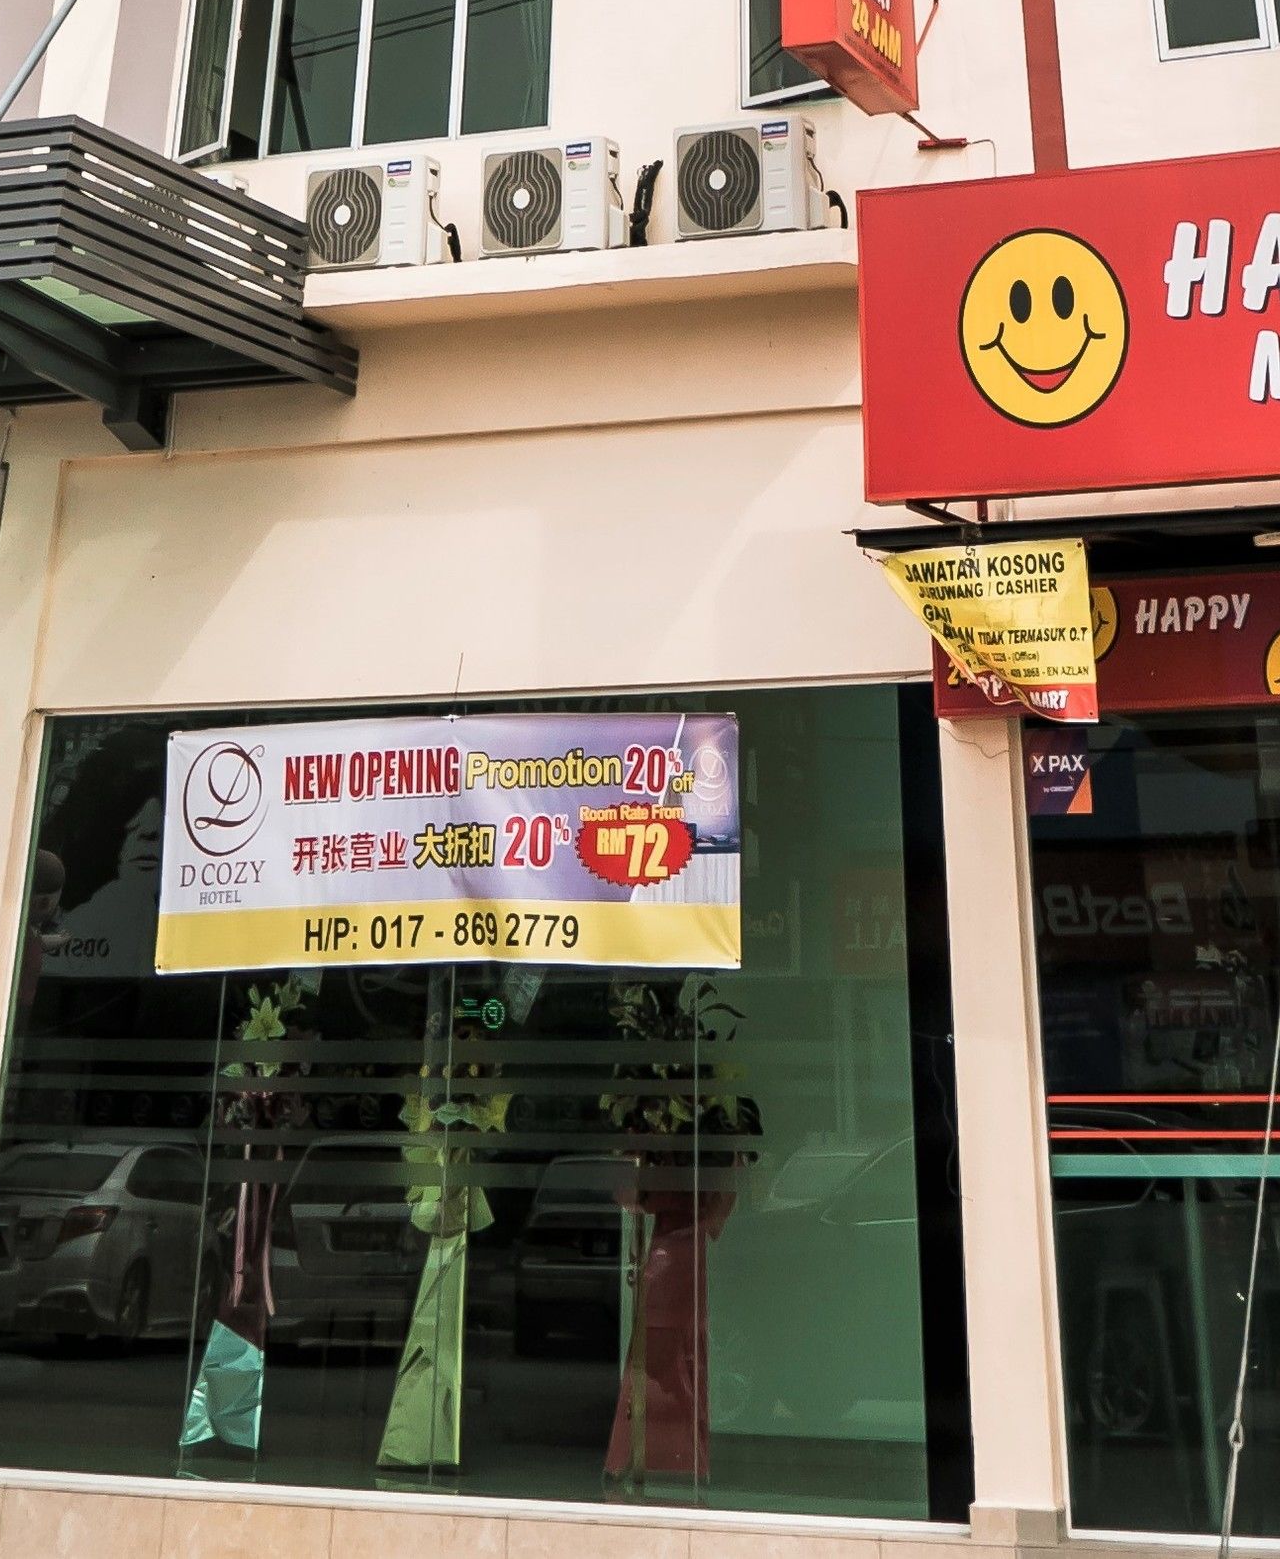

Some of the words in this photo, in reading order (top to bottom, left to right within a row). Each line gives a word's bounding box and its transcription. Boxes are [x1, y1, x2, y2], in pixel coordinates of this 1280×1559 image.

[871, 11, 903, 69] JAM
[904, 558, 981, 584] JAWATAN
[987, 551, 1066, 577] KOSONG
[996, 578, 1058, 596] CASHIER
[1134, 593, 1252, 635] HAPPY
[1008, 627, 1066, 644] TERMASUK
[1030, 689, 1069, 710] MART
[283, 754, 346, 803] NEW
[348, 746, 461, 799] OPENING
[464, 747, 623, 790] Promotion
[671, 771, 695, 793] off
[578, 805, 618, 822] Room
[620, 804, 649, 821] Rate
[651, 803, 685, 820] From
[292, 836, 407, 875] 开张营业
[413, 825, 495, 870] 大折扣
[180, 866, 197, 888] D
[201, 859, 267, 888] COZY
[199, 890, 242, 906] HOTEL
[304, 918, 359, 953] H/P:
[370, 914, 426, 950] 017
[453, 913, 498, 948] 869
[505, 914, 580, 949] 2779
